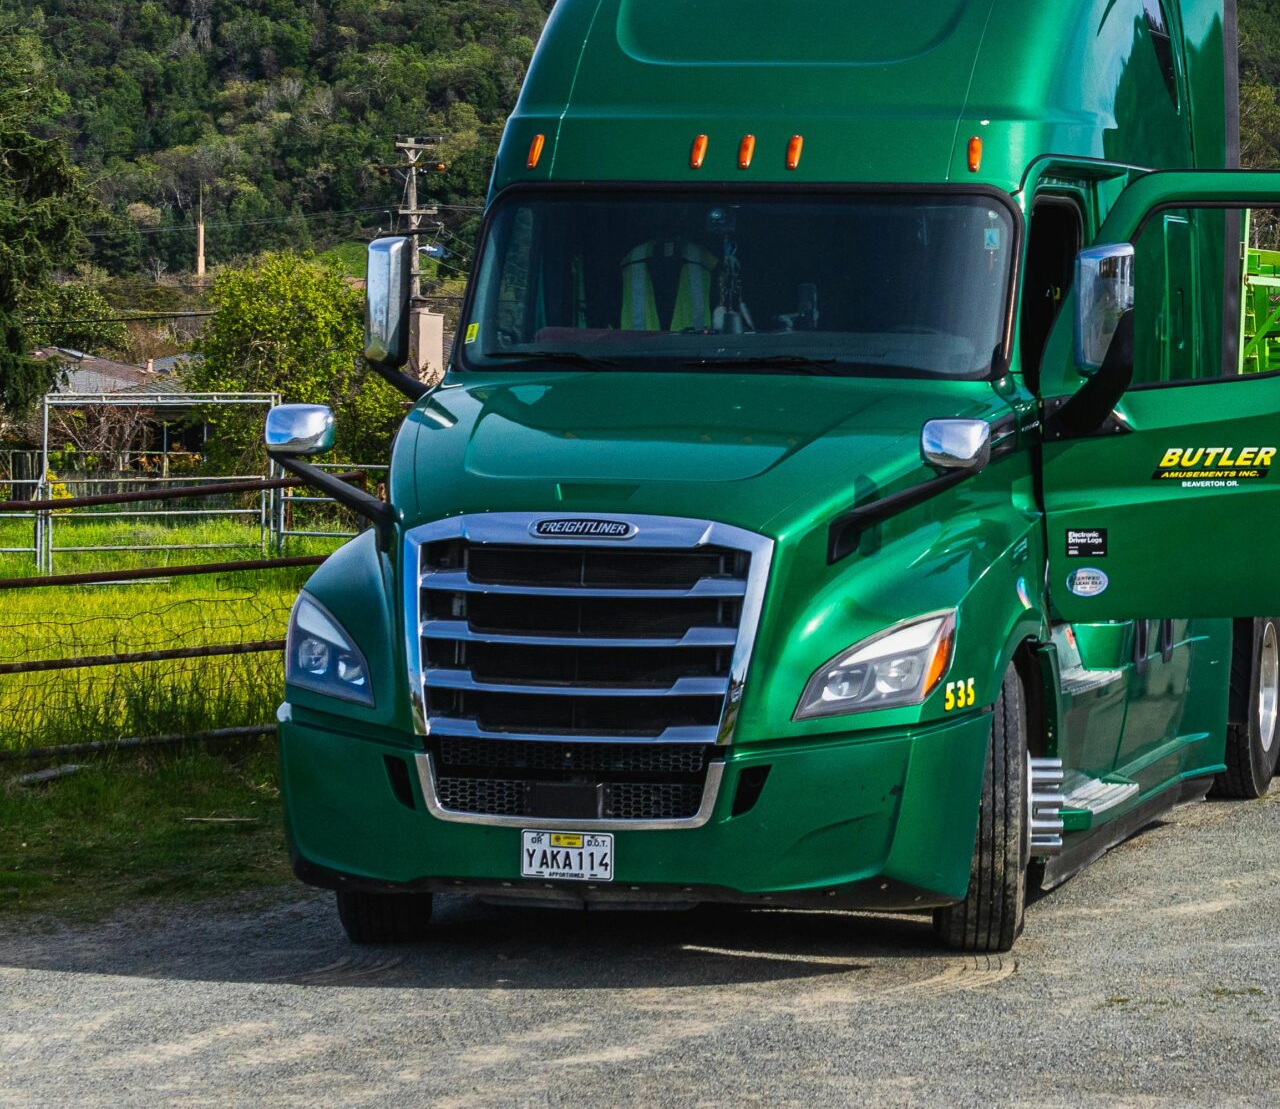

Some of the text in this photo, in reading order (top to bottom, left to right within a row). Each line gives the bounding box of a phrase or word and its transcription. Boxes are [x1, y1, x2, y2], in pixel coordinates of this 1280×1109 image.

[1158, 447, 1278, 467] BUTLER
[539, 521, 626, 534] FREIGHTLINER
[945, 677, 975, 711] 535
[531, 836, 543, 844] OR
[526, 848, 609, 872] YAKA114
[548, 871, 585, 879] APPORTIONED
